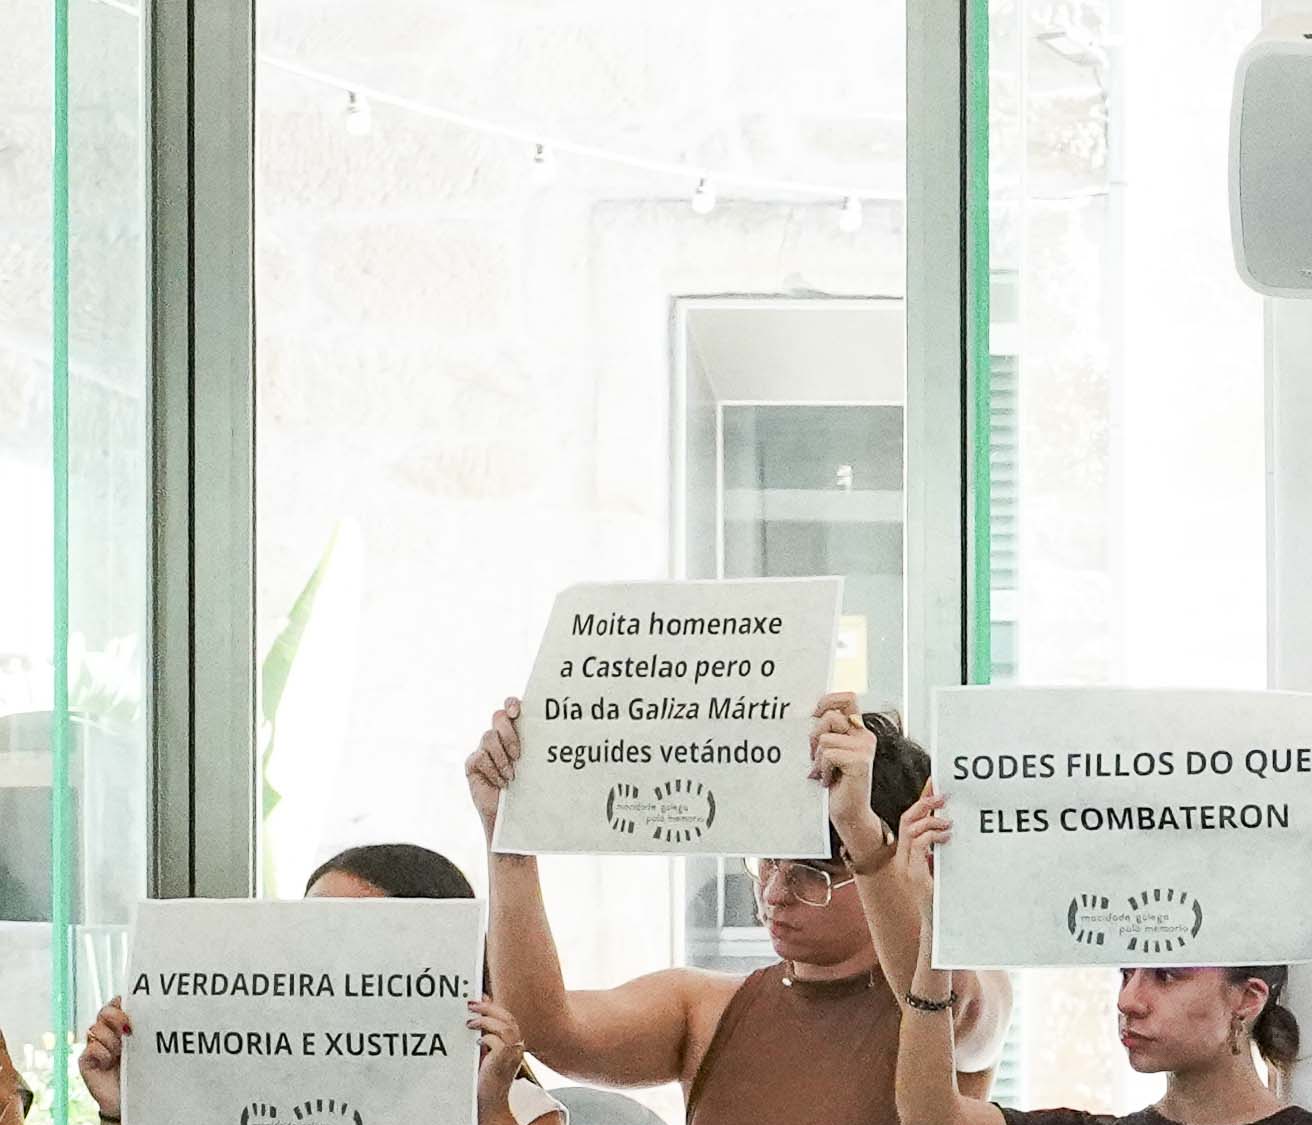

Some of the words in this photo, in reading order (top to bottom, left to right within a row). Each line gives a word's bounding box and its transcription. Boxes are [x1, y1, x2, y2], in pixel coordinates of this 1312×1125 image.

[572, 612, 640, 637] Moita
[649, 611, 783, 636] homenaxe
[560, 660, 573, 678] a
[582, 654, 688, 678] Castelao
[694, 659, 751, 685] pero
[760, 659, 775, 678] o
[545, 696, 583, 721] Día
[591, 696, 620, 720] da
[628, 697, 700, 721] Galiza
[708, 695, 791, 720] Mártir
[547, 738, 652, 770] seguides
[659, 738, 781, 764] vetándoo
[953, 753, 1055, 781] SODES
[1067, 751, 1175, 778] FILLOS
[1186, 750, 1233, 775] DO
[1245, 748, 1312, 779] QUE
[979, 808, 1049, 834] ELES
[1060, 804, 1289, 832] COMBATERON
[132, 973, 150, 996] A
[159, 972, 335, 997] VERDADEIRA
[344, 967, 469, 999] LEICIÓN:
[155, 1030, 293, 1056] MEMORIA
[302, 1032, 316, 1056] E
[324, 1032, 448, 1057] XUSTIZA
